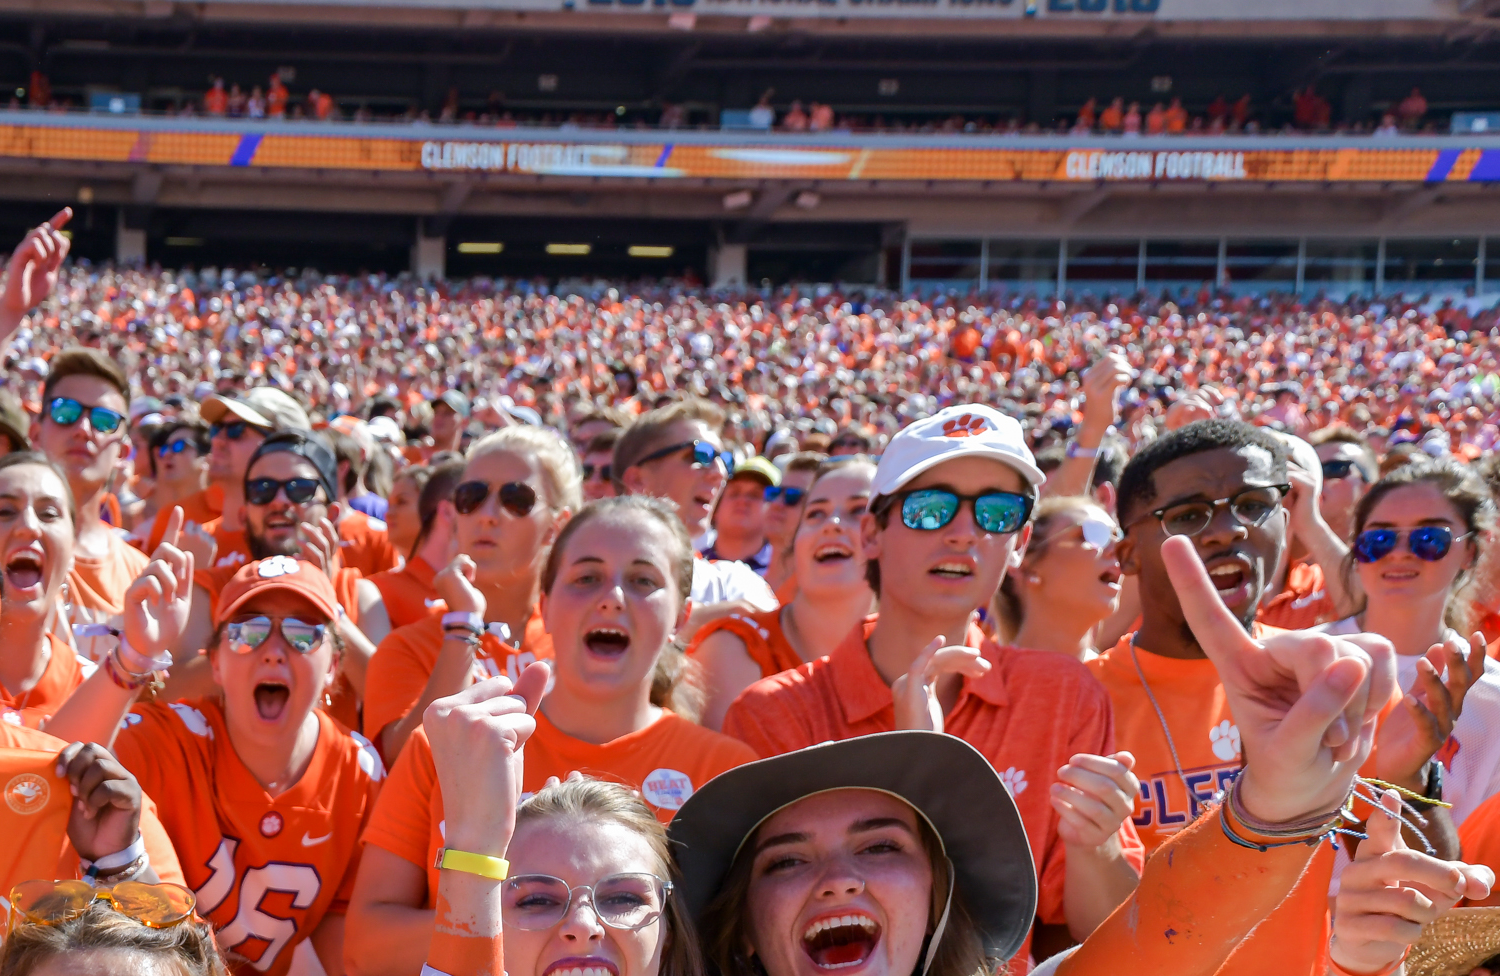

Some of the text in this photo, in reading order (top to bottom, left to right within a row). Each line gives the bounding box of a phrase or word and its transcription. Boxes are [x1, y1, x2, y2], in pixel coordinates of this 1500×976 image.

[421, 141, 504, 169] CLEMSON
[1066, 151, 1247, 178] CLEMSON FOOTBALL
